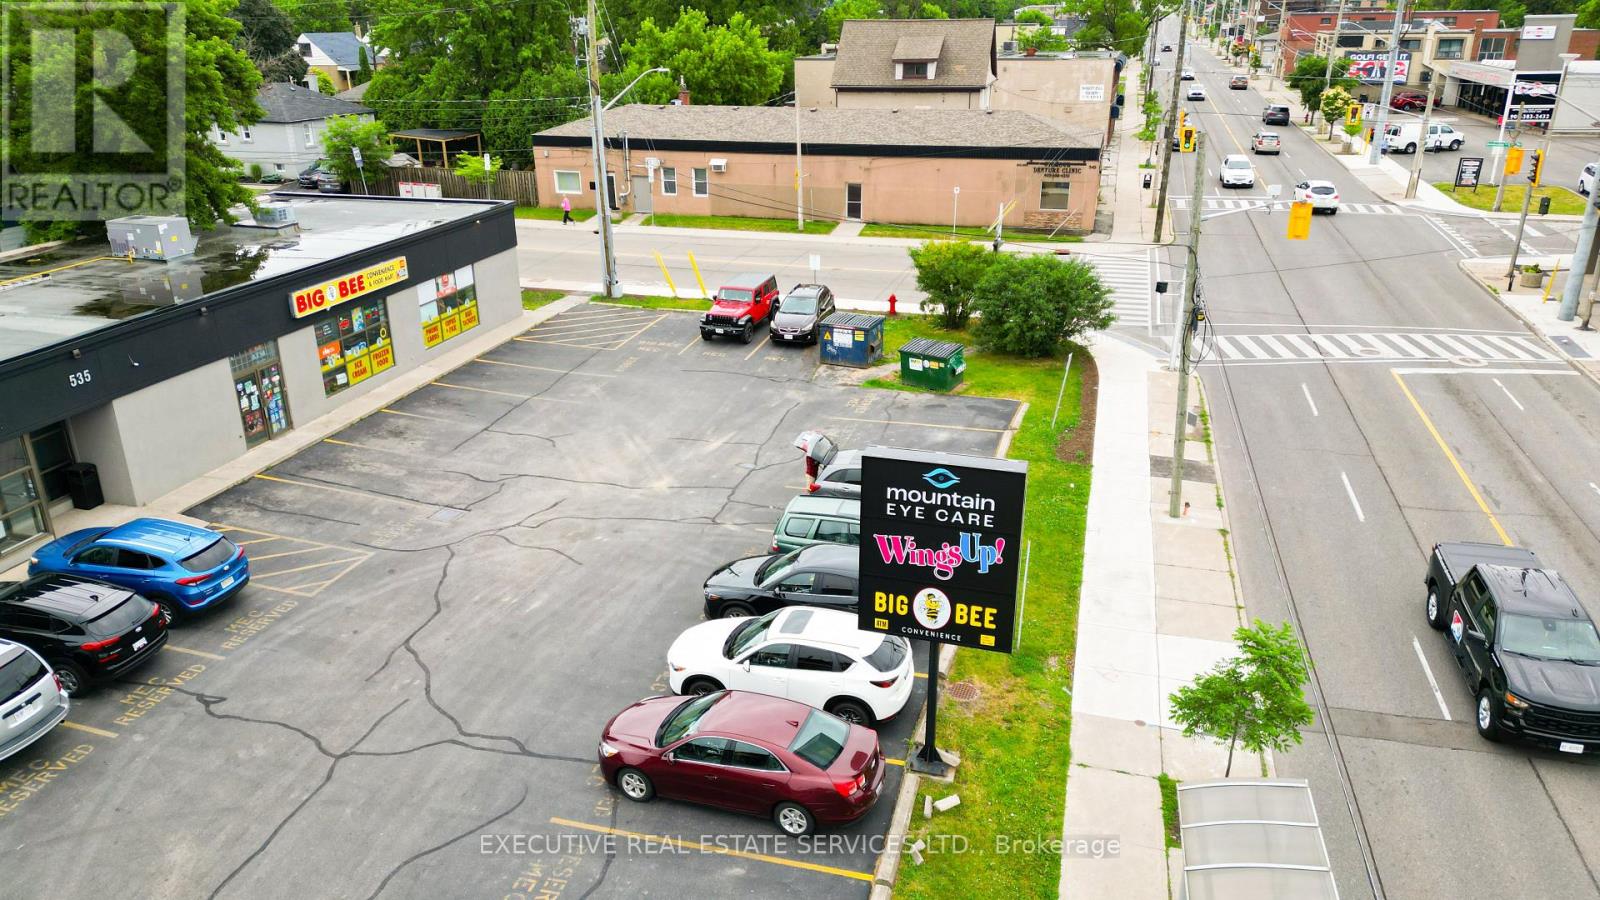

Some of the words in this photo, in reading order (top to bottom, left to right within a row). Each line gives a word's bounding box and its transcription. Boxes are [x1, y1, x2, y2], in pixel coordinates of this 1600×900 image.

[366, 265, 395, 280] CONVENIENCE
[296, 289, 325, 313] BIG
[338, 275, 365, 298] BEE
[354, 359, 362, 368] ICE
[372, 348, 389, 360] FROZEN
[376, 357, 389, 367] FOOD
[69, 369, 91, 387] 535
[352, 367, 368, 379] CREAM
[886, 486, 995, 511] mountain
[886, 503, 925, 519] EYE
[935, 509, 995, 528] CARE
[874, 591, 908, 615] BIG
[955, 603, 998, 630] BEE
[220, 599, 299, 650] RESERVED
[223, 610, 265, 633] MEC
[875, 620, 888, 628] ATM
[901, 626, 962, 642] CONVENIENCE
[112, 664, 206, 726] RESERVED
[119, 677, 167, 706] MEC
